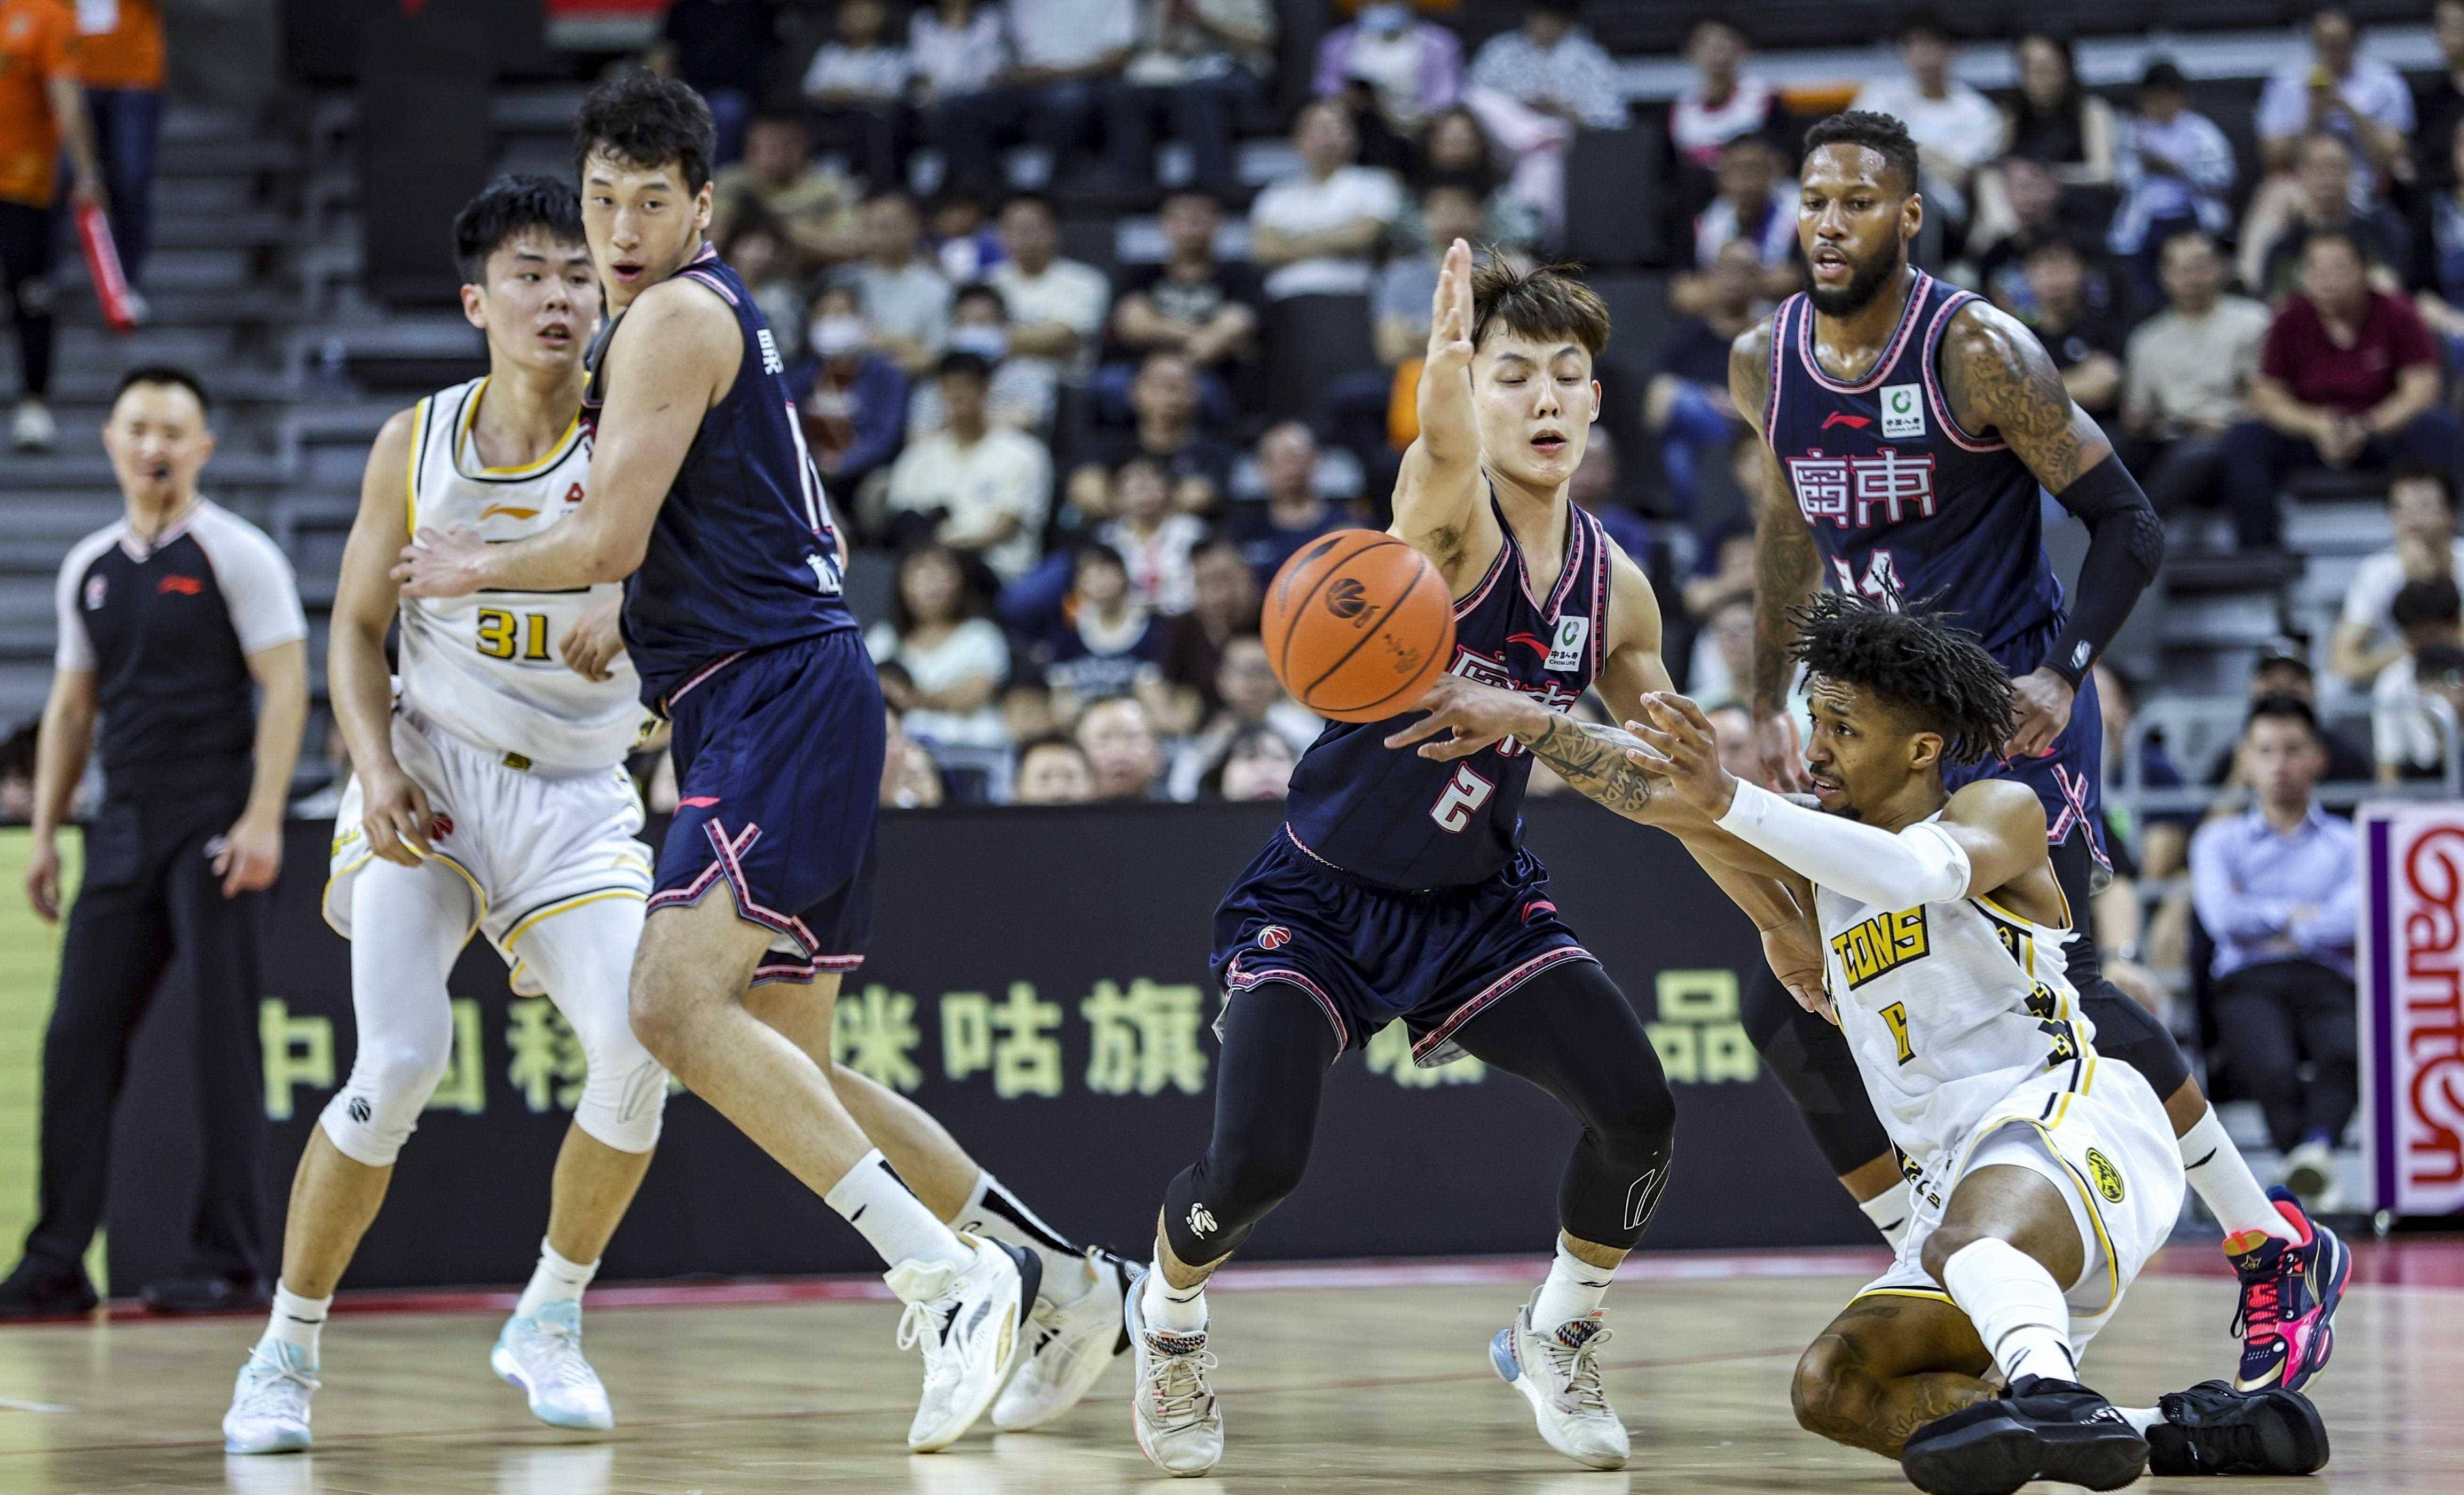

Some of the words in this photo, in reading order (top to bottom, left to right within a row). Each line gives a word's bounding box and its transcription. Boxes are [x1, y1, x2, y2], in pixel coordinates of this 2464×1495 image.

[477, 608, 551, 661] 31
[1429, 760, 1495, 833] 2
[1878, 1001, 1916, 1066] 6
